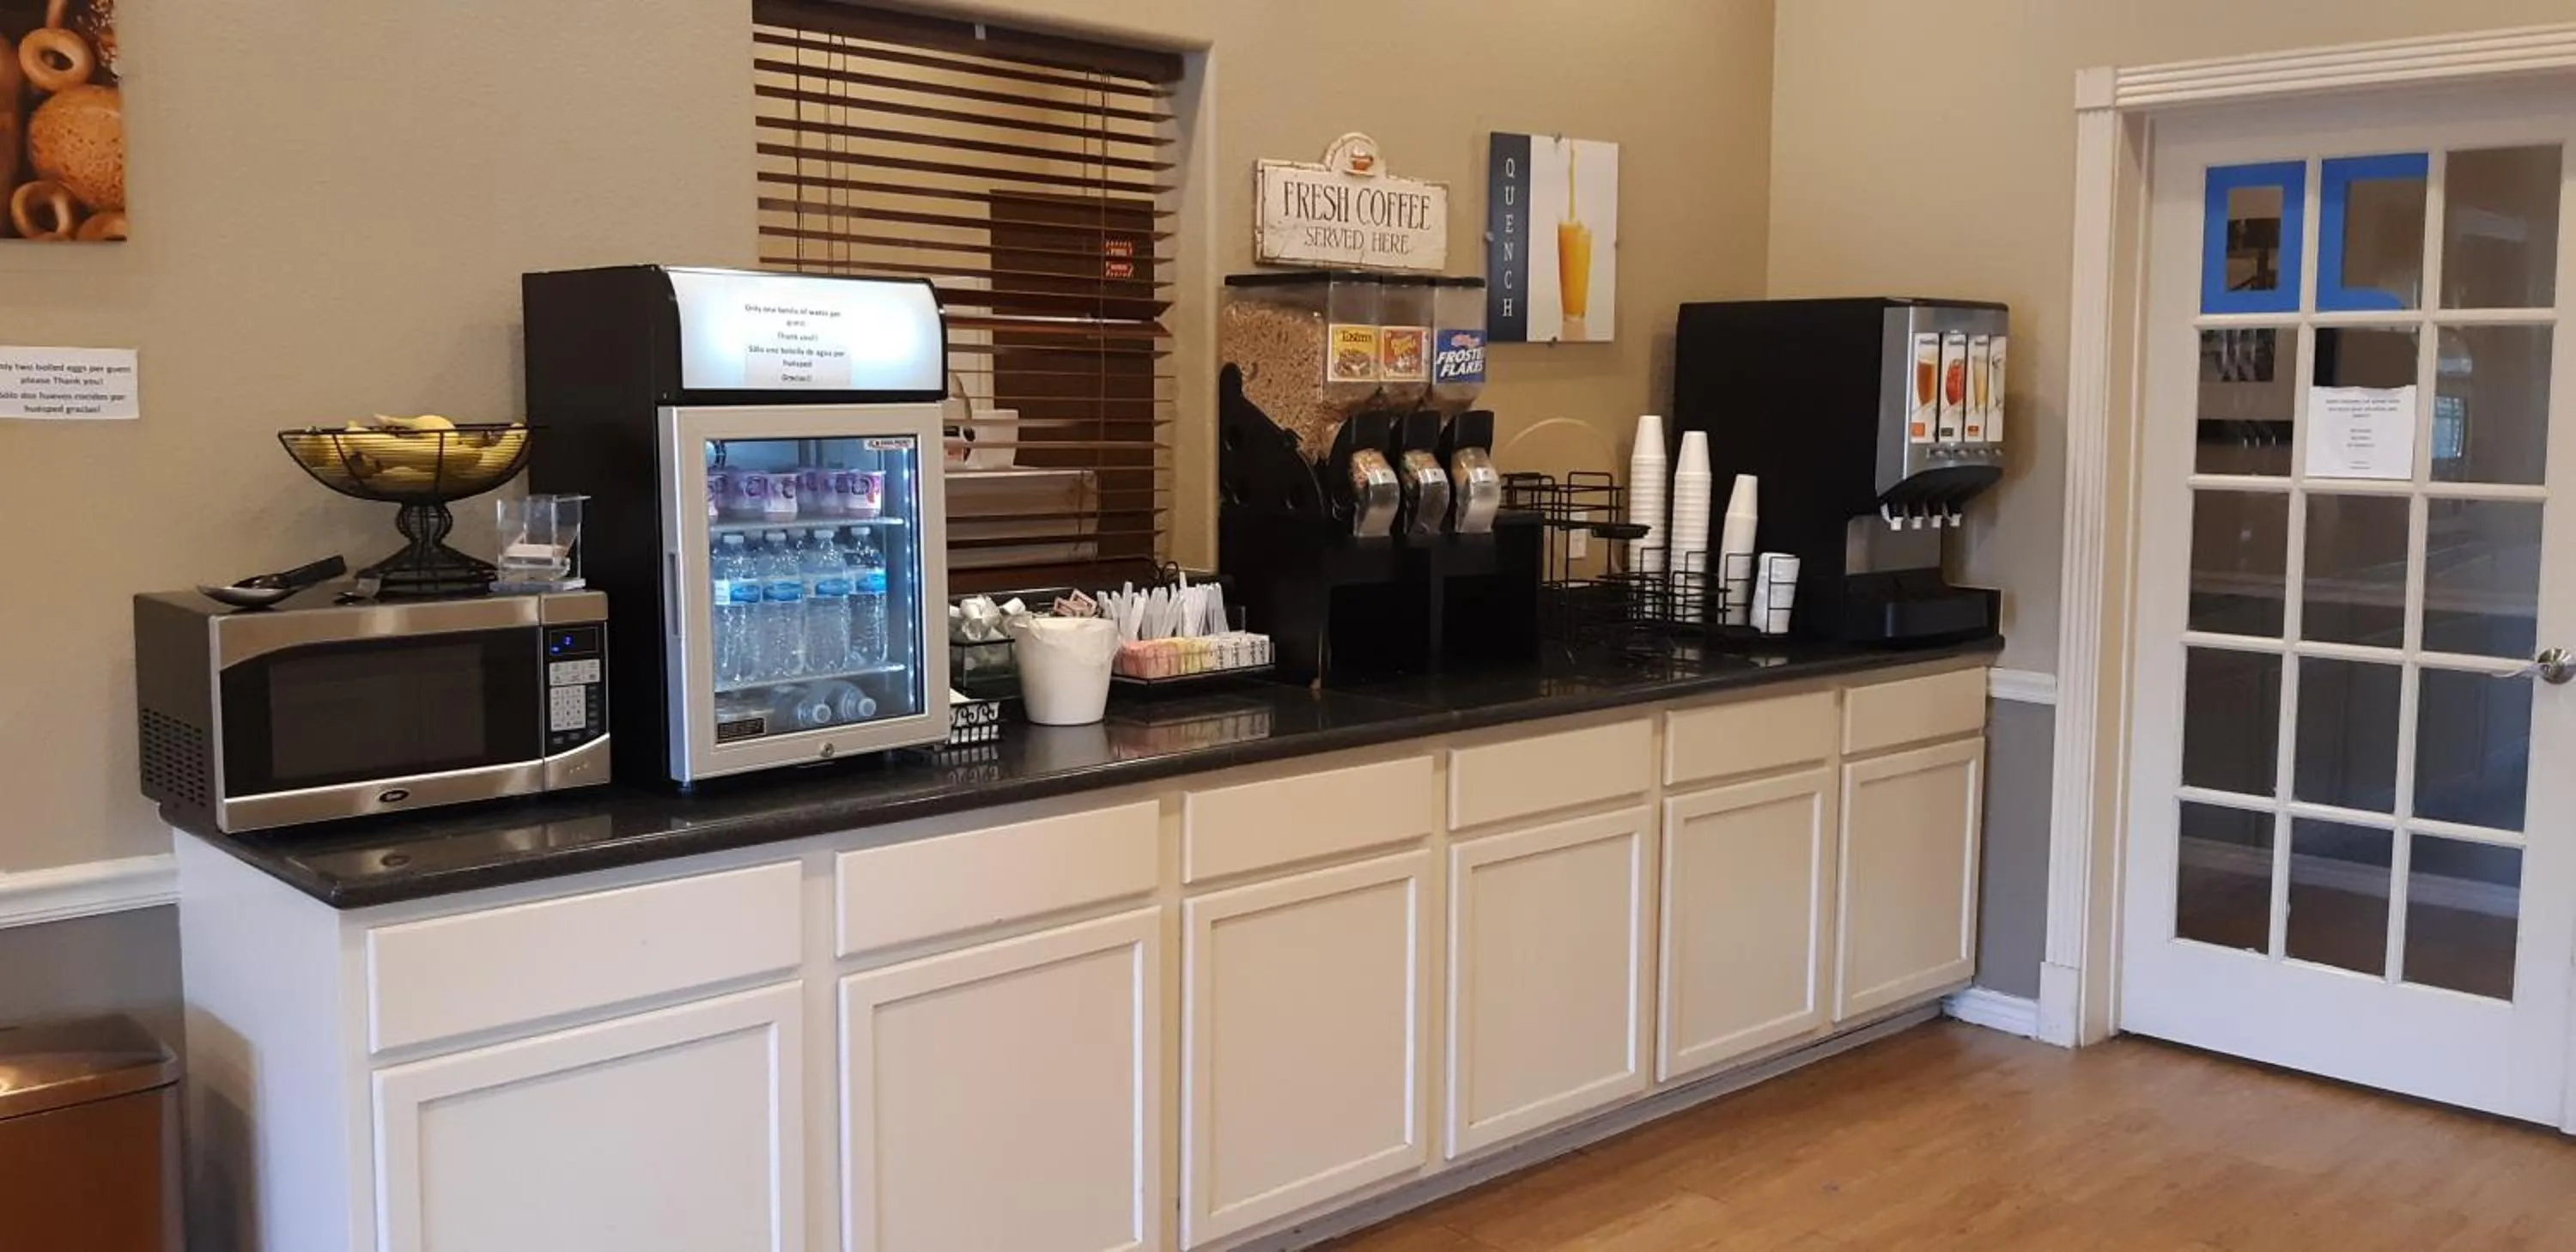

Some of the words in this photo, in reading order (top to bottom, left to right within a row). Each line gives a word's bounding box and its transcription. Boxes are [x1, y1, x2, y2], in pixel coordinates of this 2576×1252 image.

[1284, 181, 1349, 222] FRESH
[1356, 187, 1431, 231] COFFEE
[1303, 226, 1364, 251] SERVED
[1371, 232, 1410, 256] HERE
[1502, 157, 1516, 318] QUENCH
[744, 304, 762, 313] Only
[0, 363, 13, 372] nly
[15, 363, 33, 372] two
[36, 363, 64, 372] boiled
[67, 365, 87, 374] eggs
[88, 366, 104, 374] per
[1440, 360, 1484, 378] FLAKES
[21, 376, 51, 386] please
[53, 376, 81, 386] Thank
[39, 391, 72, 400] huevos
